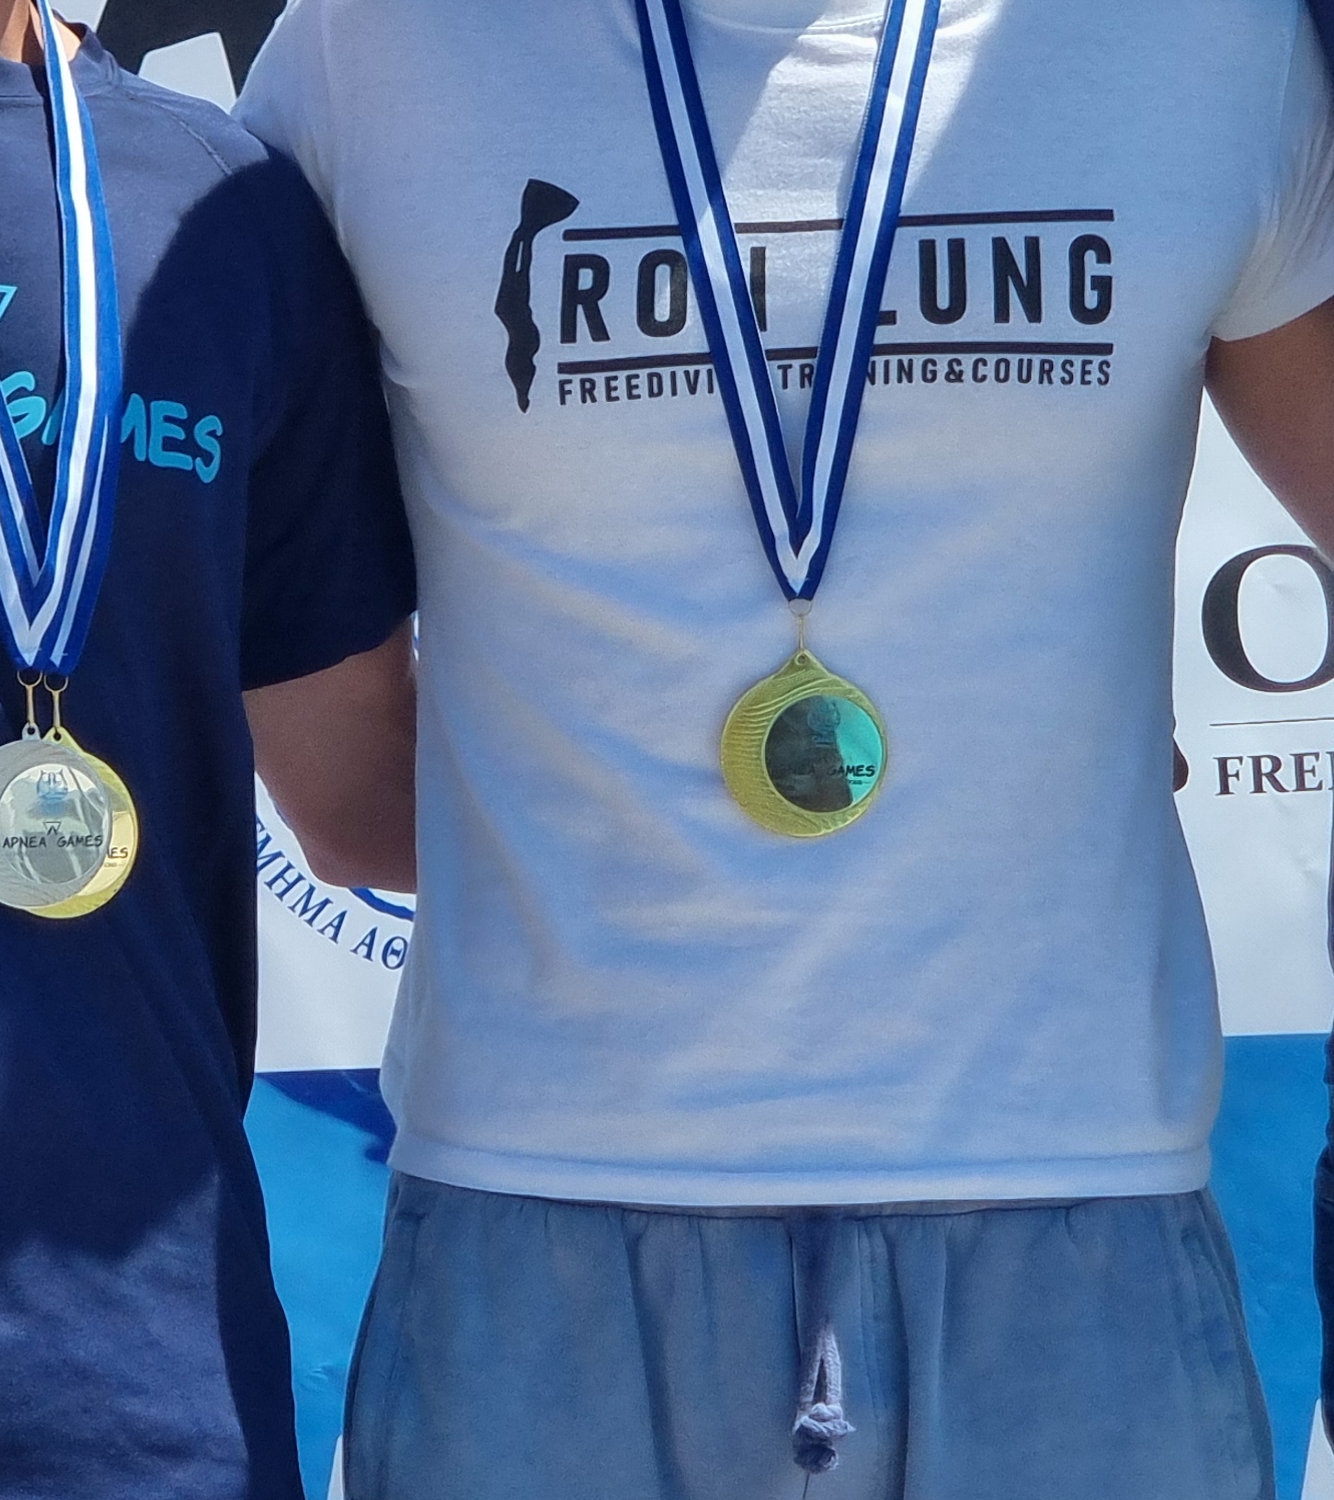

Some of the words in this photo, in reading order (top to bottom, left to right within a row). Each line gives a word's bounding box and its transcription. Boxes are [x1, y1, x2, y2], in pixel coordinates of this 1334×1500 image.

[559, 366, 716, 406] FREEDIVI
[2, 836, 47, 849] APNEA
[56, 834, 103, 848] GAMES
